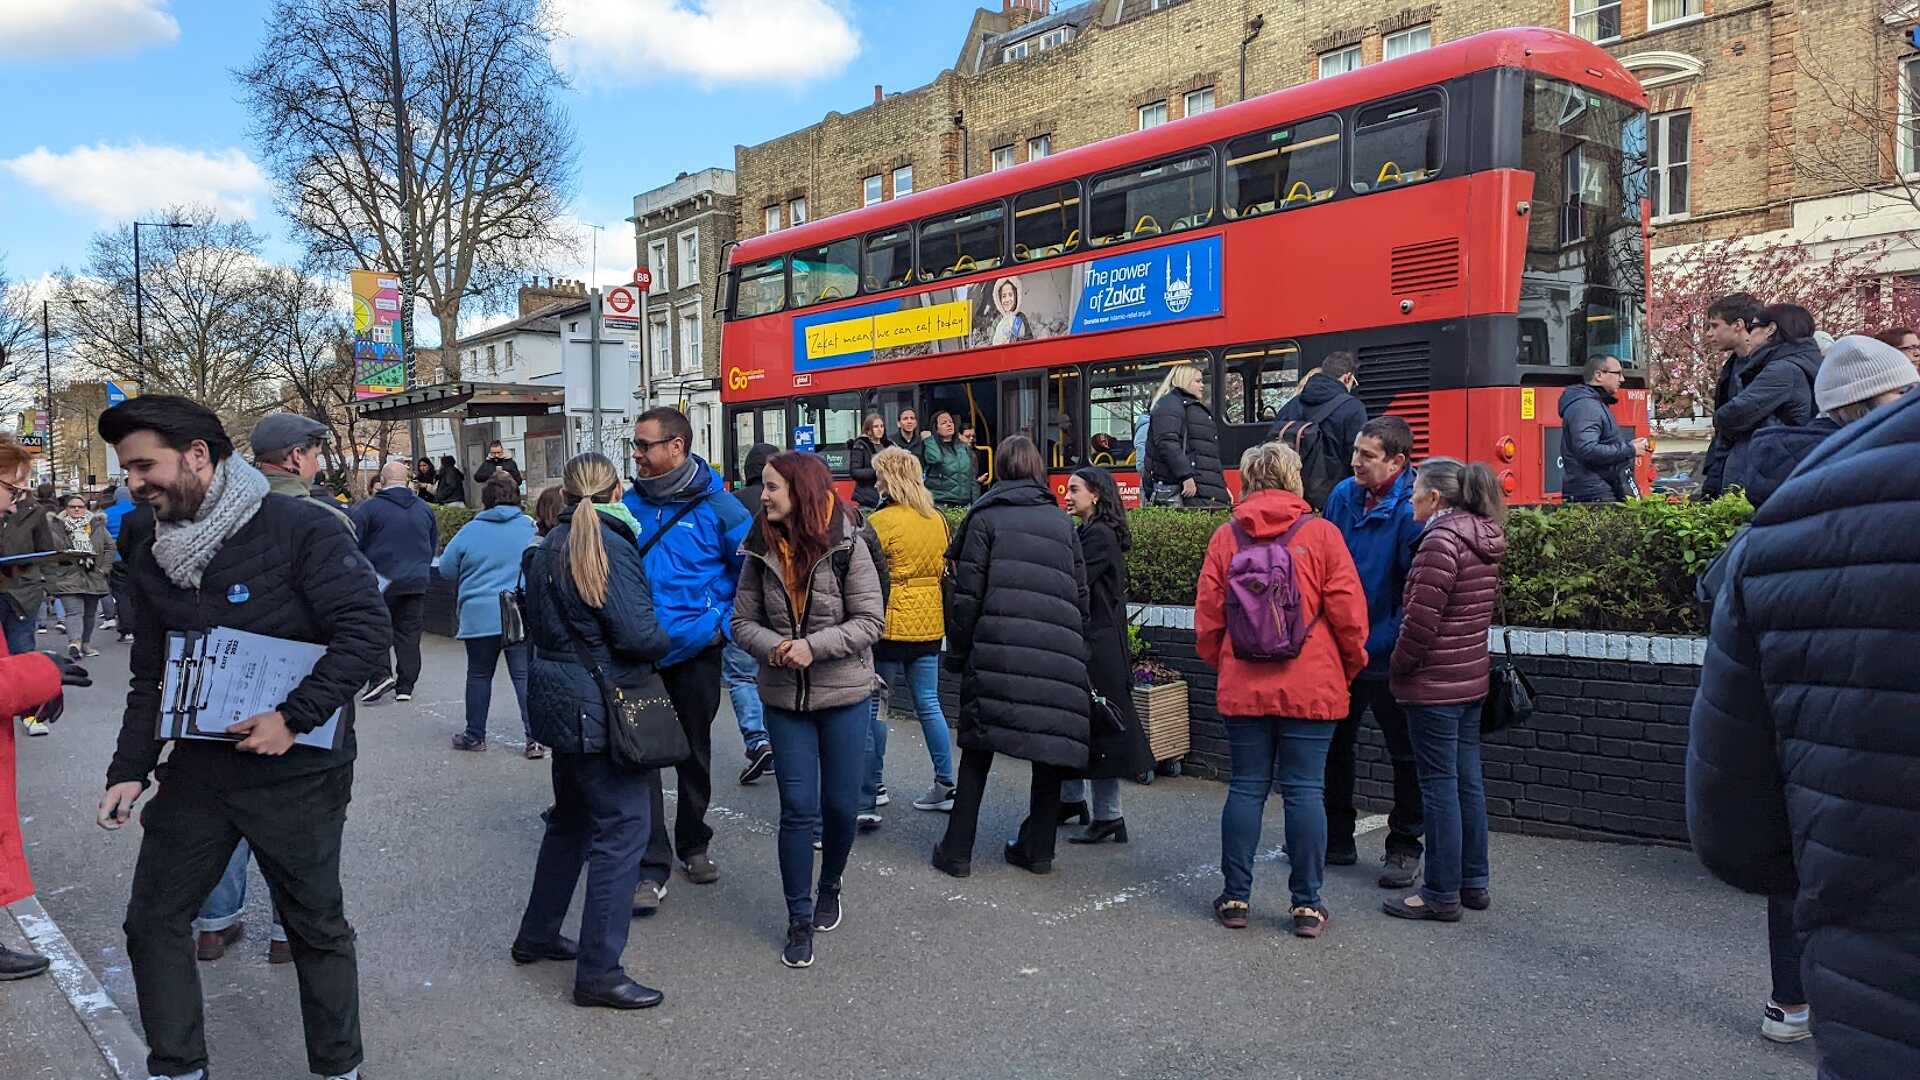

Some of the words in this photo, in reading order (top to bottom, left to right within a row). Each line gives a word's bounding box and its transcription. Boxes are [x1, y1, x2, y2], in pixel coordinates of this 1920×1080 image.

[637, 273, 649, 281] BB
[1085, 268, 1108, 288] The
[1110, 261, 1152, 287] power
[1089, 290, 1104, 313] of
[1104, 283, 1146, 307] Zakat
[877, 327, 890, 339] we
[894, 326, 912, 336] can
[916, 316, 932, 334] eat
[729, 366, 748, 390] Go
[17, 436, 42, 446] TAXI
